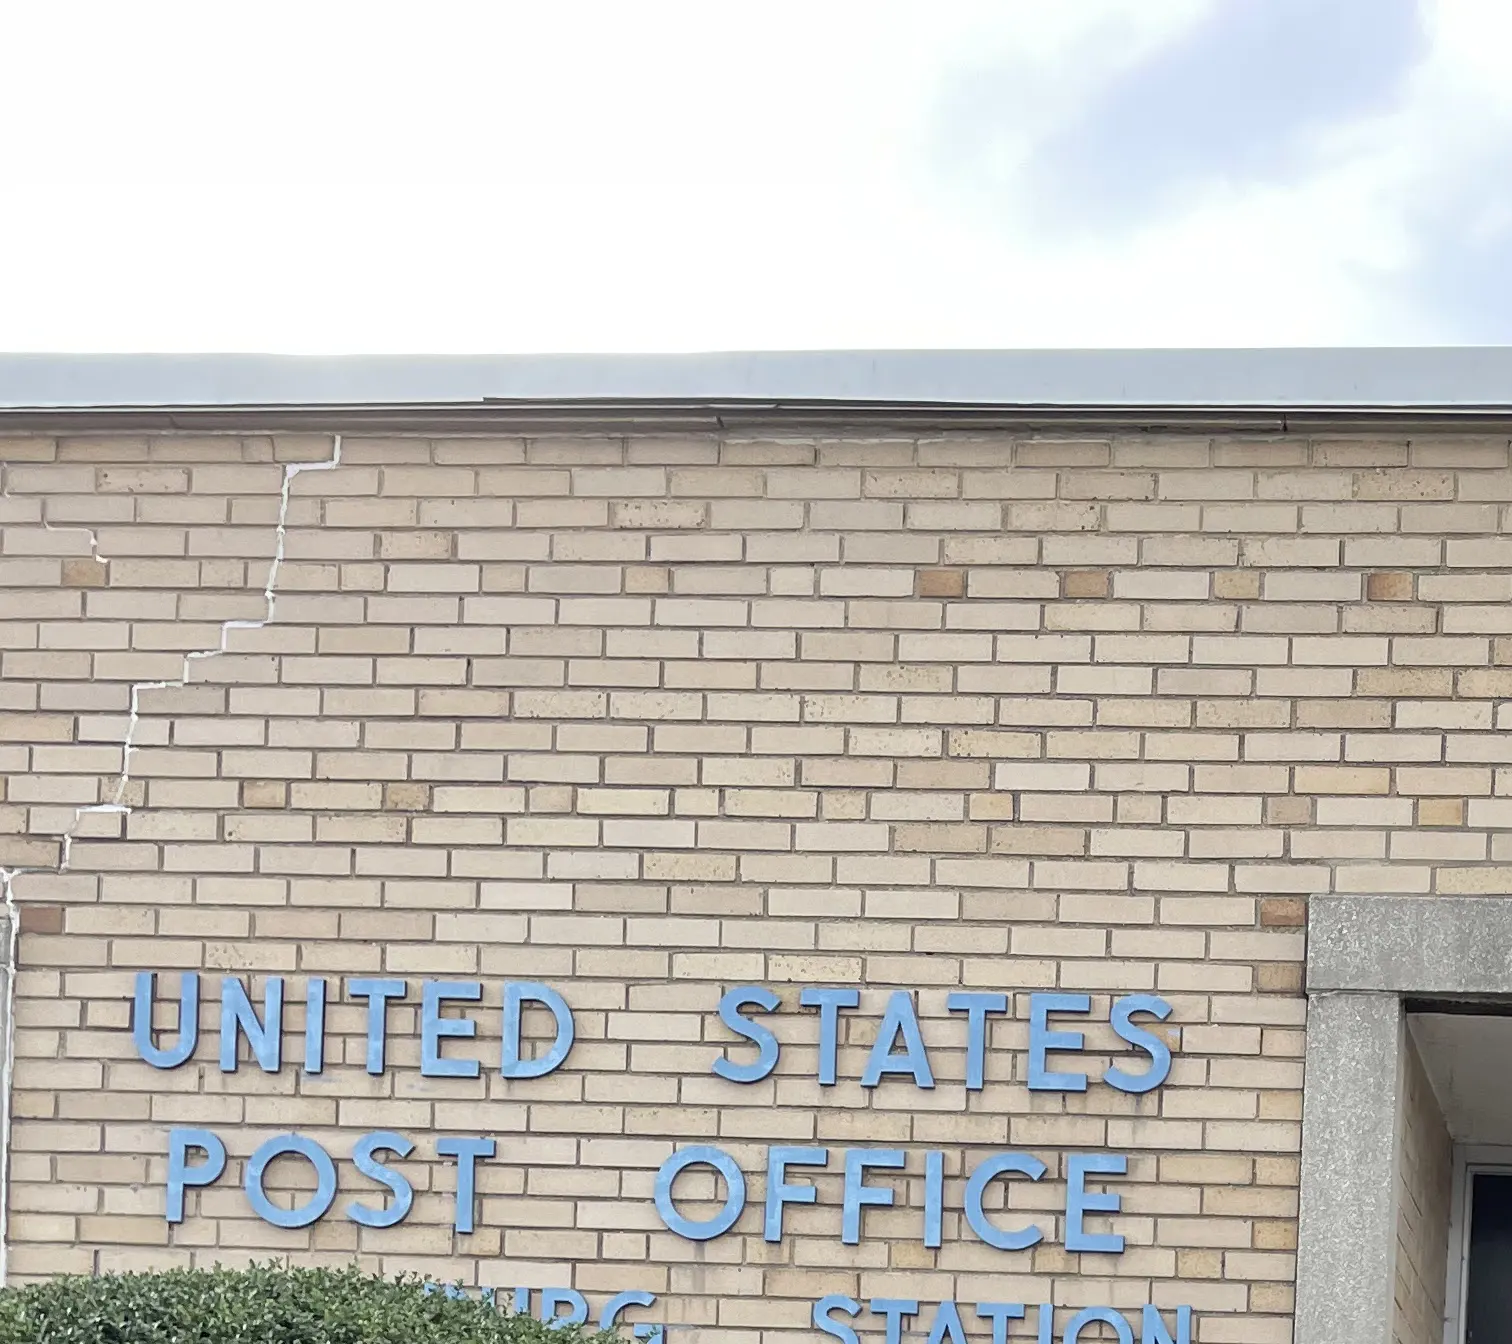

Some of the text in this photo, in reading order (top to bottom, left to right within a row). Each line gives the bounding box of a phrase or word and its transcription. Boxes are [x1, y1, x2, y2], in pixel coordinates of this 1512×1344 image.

[130, 972, 1172, 1094] UNITED STATES
[165, 1128, 1127, 1253] POST OFFICE
